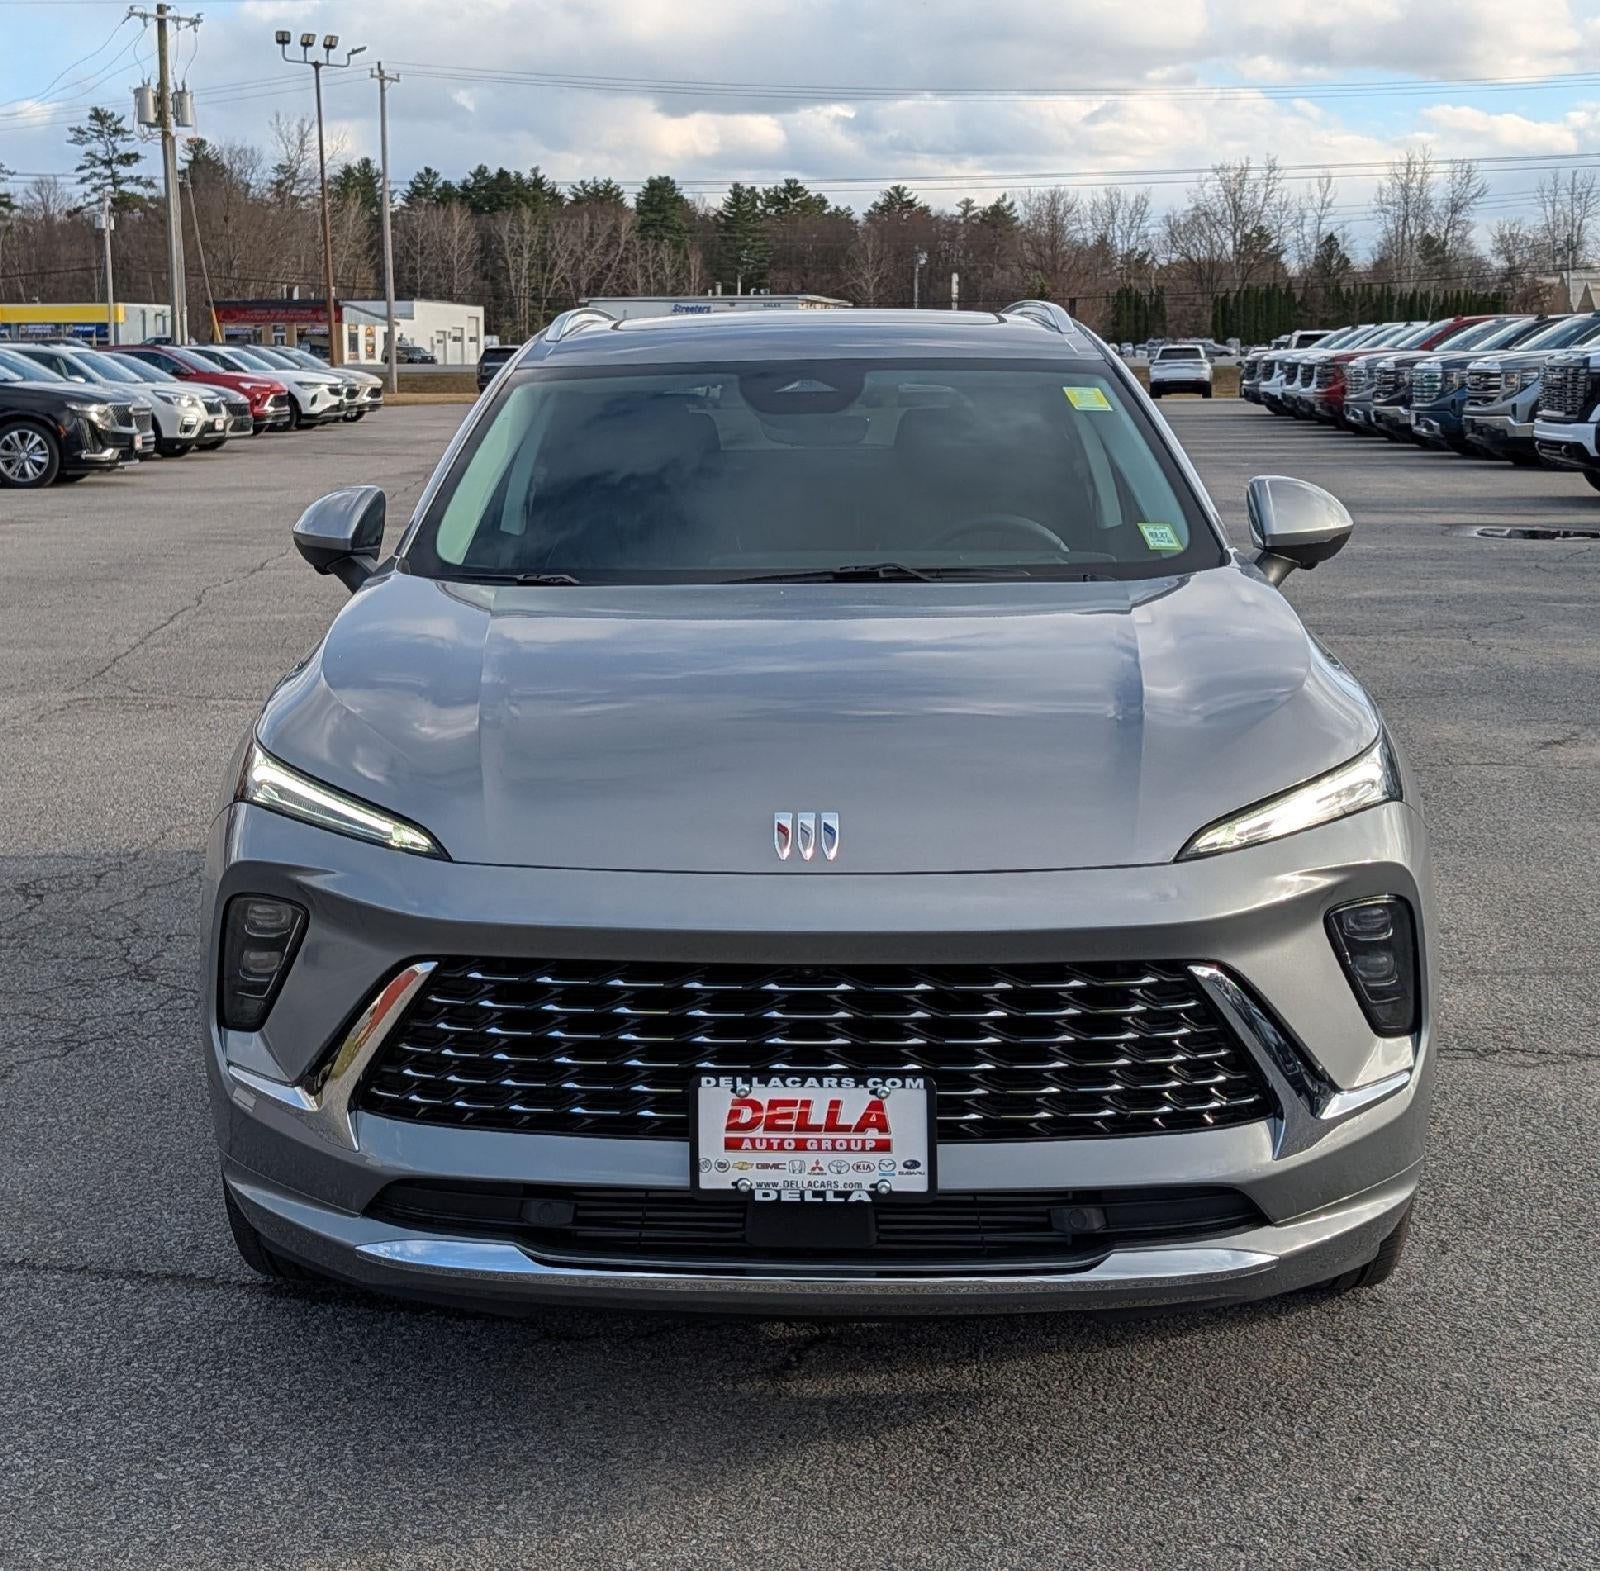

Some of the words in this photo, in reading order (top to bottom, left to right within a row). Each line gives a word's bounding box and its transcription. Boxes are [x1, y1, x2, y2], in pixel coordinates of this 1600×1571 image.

[672, 304, 712, 314] Streeters
[700, 1076, 925, 1089] DELLACARS.COM
[724, 1098, 891, 1135] DELLA
[740, 1138, 797, 1151] AUTO
[806, 1138, 877, 1151] GROUP
[755, 1162, 786, 1170] GMC
[855, 1163, 872, 1171] KIA
[755, 1179, 863, 1190] www.DELLACARS.com
[754, 1189, 872, 1202] DELLA
